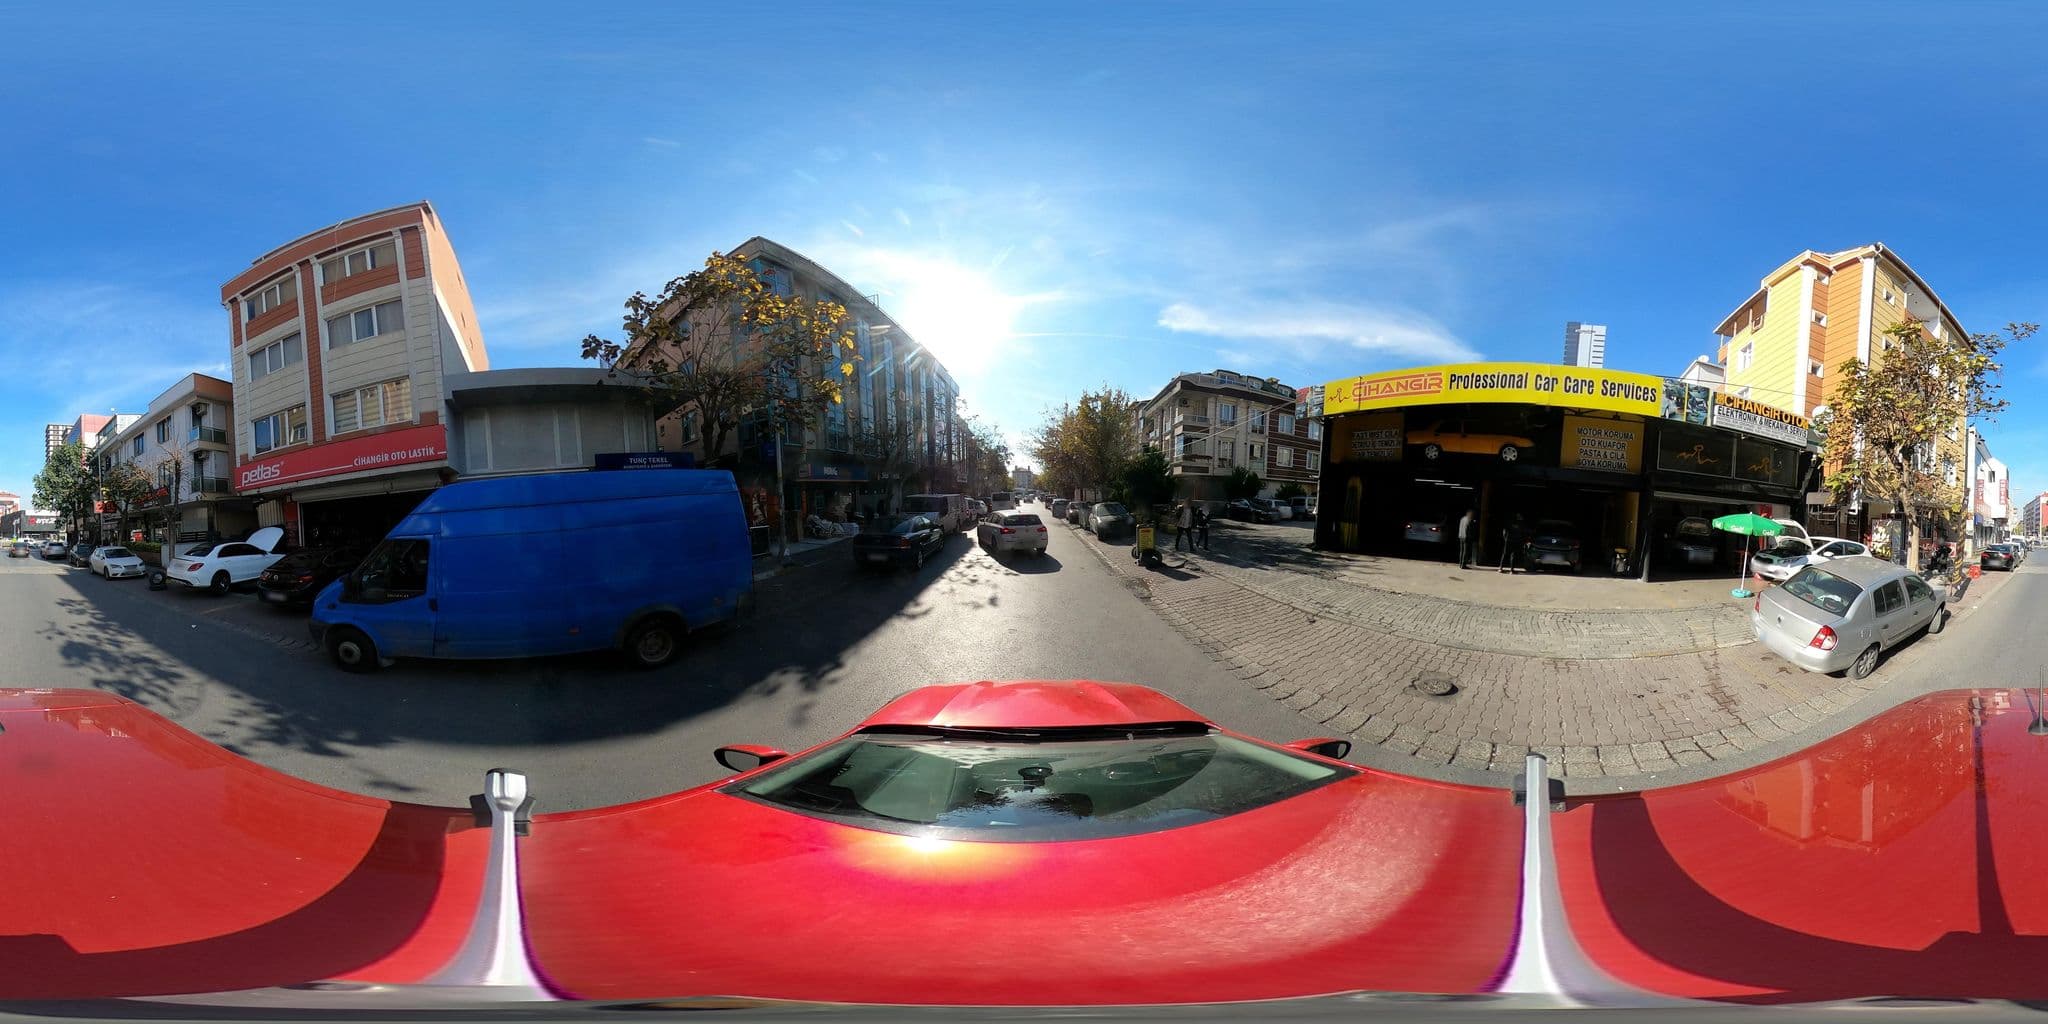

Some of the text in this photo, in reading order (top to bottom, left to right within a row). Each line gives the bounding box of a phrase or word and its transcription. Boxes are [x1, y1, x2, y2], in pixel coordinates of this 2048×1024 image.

[1449, 372, 1529, 390] Professional
[1534, 374, 1558, 393] Car
[1564, 375, 1595, 395] Care
[1601, 379, 1657, 402] Services
[1577, 427, 1634, 440] MOTOR KORUMA
[1581, 438, 1596, 447] OTO
[353, 445, 435, 466] CİHANGİR OTO LASTİK
[1580, 448, 1602, 458] PASTA
[1597, 460, 1627, 470] KORUMA
